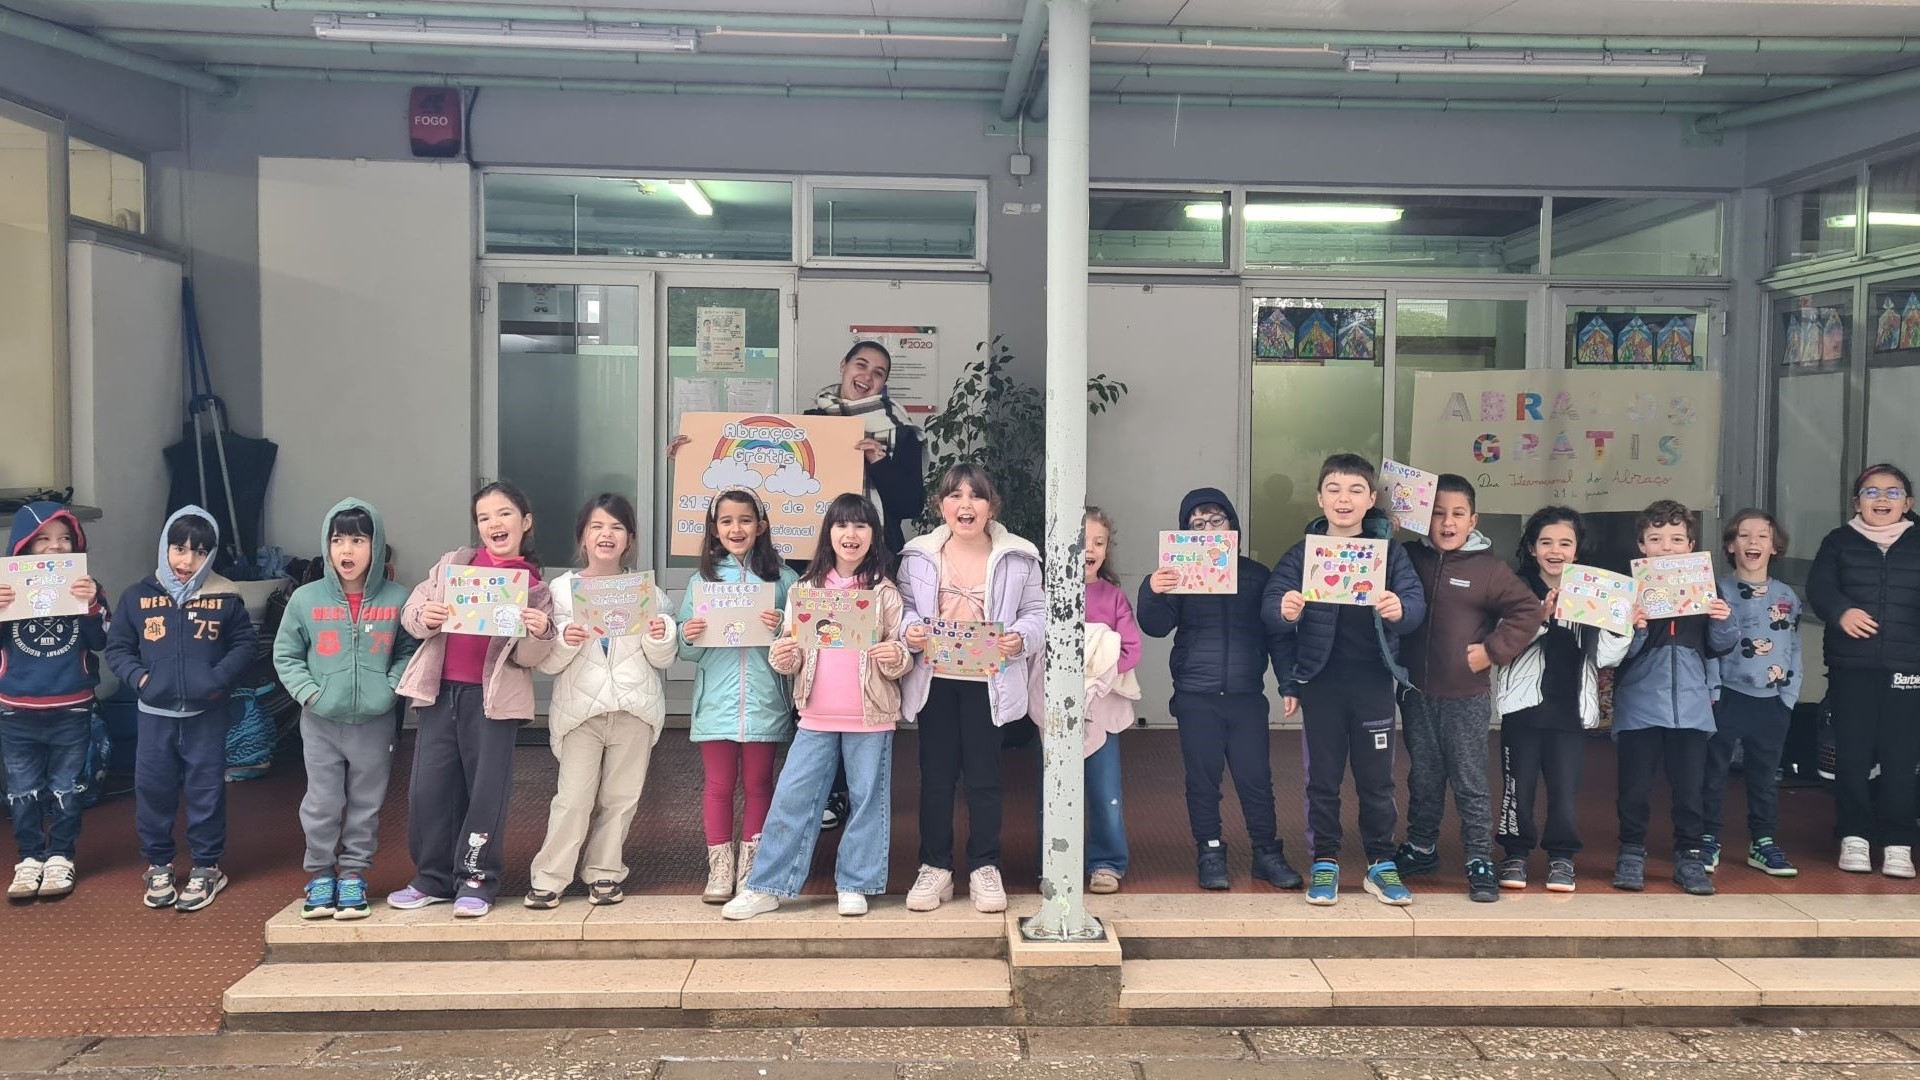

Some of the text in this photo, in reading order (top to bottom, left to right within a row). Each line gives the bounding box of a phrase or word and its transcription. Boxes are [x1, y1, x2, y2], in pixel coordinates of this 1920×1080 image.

[414, 115, 448, 127] FOGO
[907, 340, 933, 349] 2020
[724, 422, 806, 445] Abraços
[732, 446, 796, 465] Grátis
[679, 495, 697, 509] 21
[782, 501, 805, 514] de
[677, 520, 705, 535] Dia
[193, 618, 221, 641] 75
